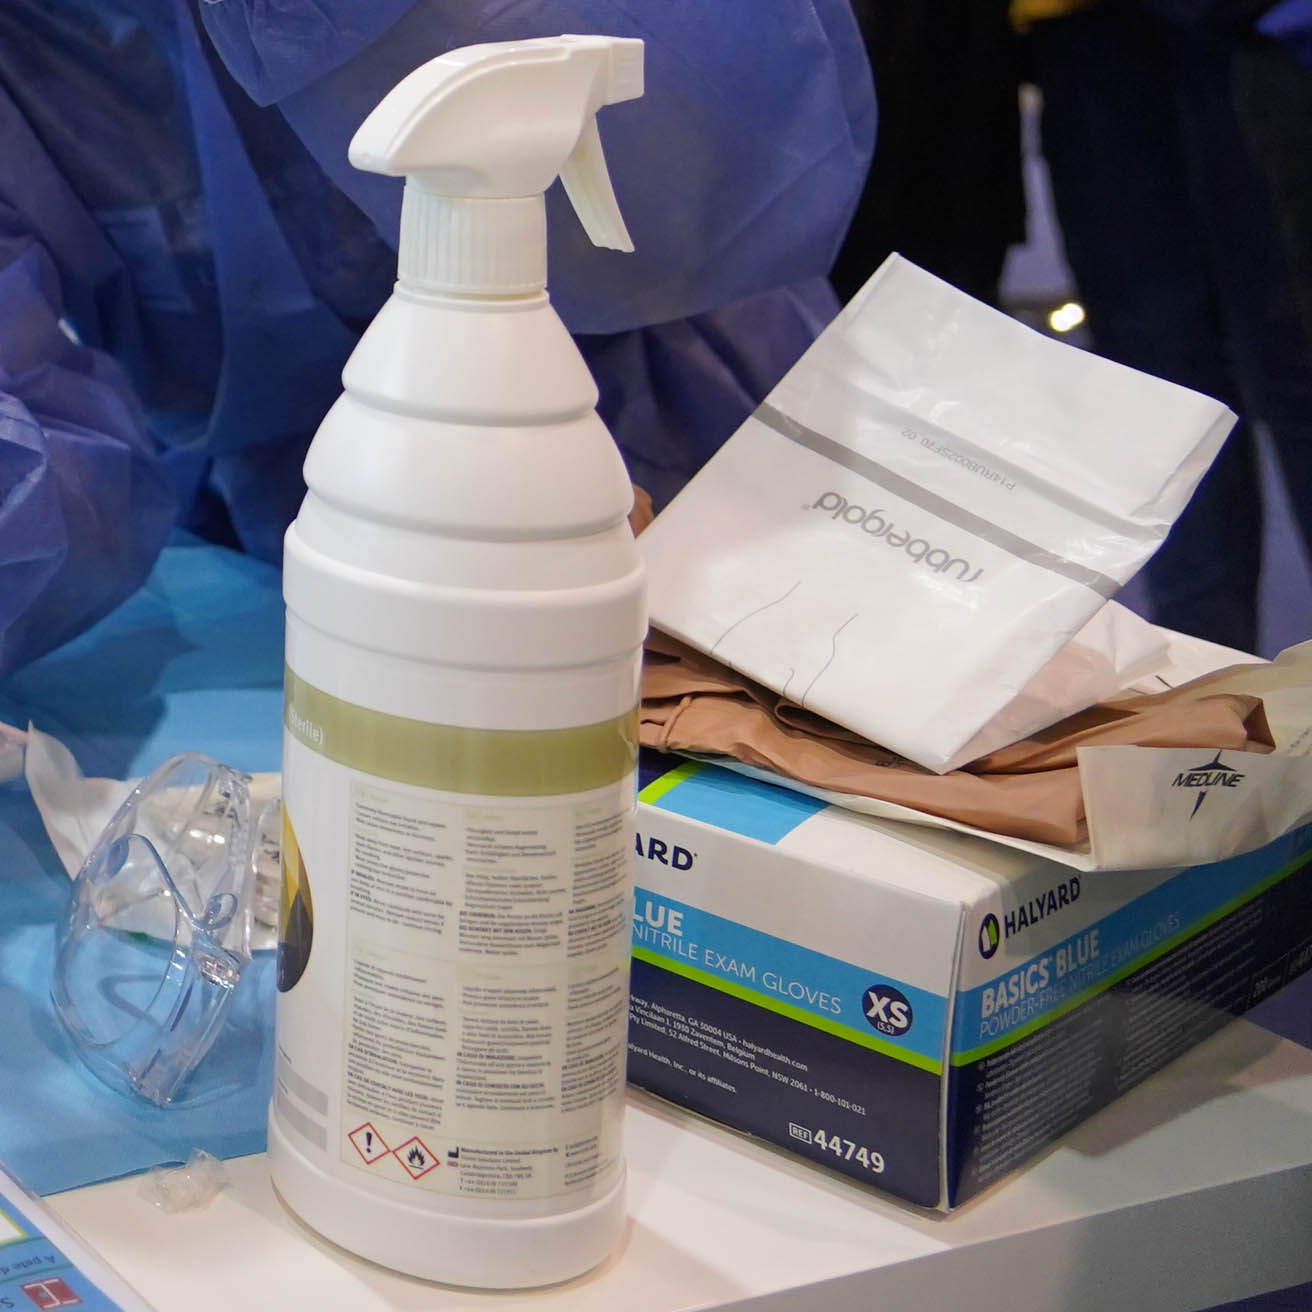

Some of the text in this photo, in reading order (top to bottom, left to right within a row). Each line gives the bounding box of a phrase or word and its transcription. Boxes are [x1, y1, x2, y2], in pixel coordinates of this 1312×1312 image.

[811, 490, 985, 582] rubbergold
[1172, 772, 1246, 788] MEDLINE
[1004, 875, 1081, 938] HALYARD
[705, 949, 756, 983] EXAM
[762, 971, 842, 1015] GLOVES
[981, 929, 1100, 1018] BASICS BLUE
[688, 1017, 699, 1028] GA
[723, 1031, 737, 1043] USA
[866, 991, 908, 1029] XS
[678, 1033, 699, 1047] Alfred
[771, 1071, 789, 1084] NSW
[727, 1042, 756, 1060] Belgium
[792, 1125, 811, 1140] REF
[813, 1129, 885, 1174] 44749
[43, 1255, 56, 1264] A
